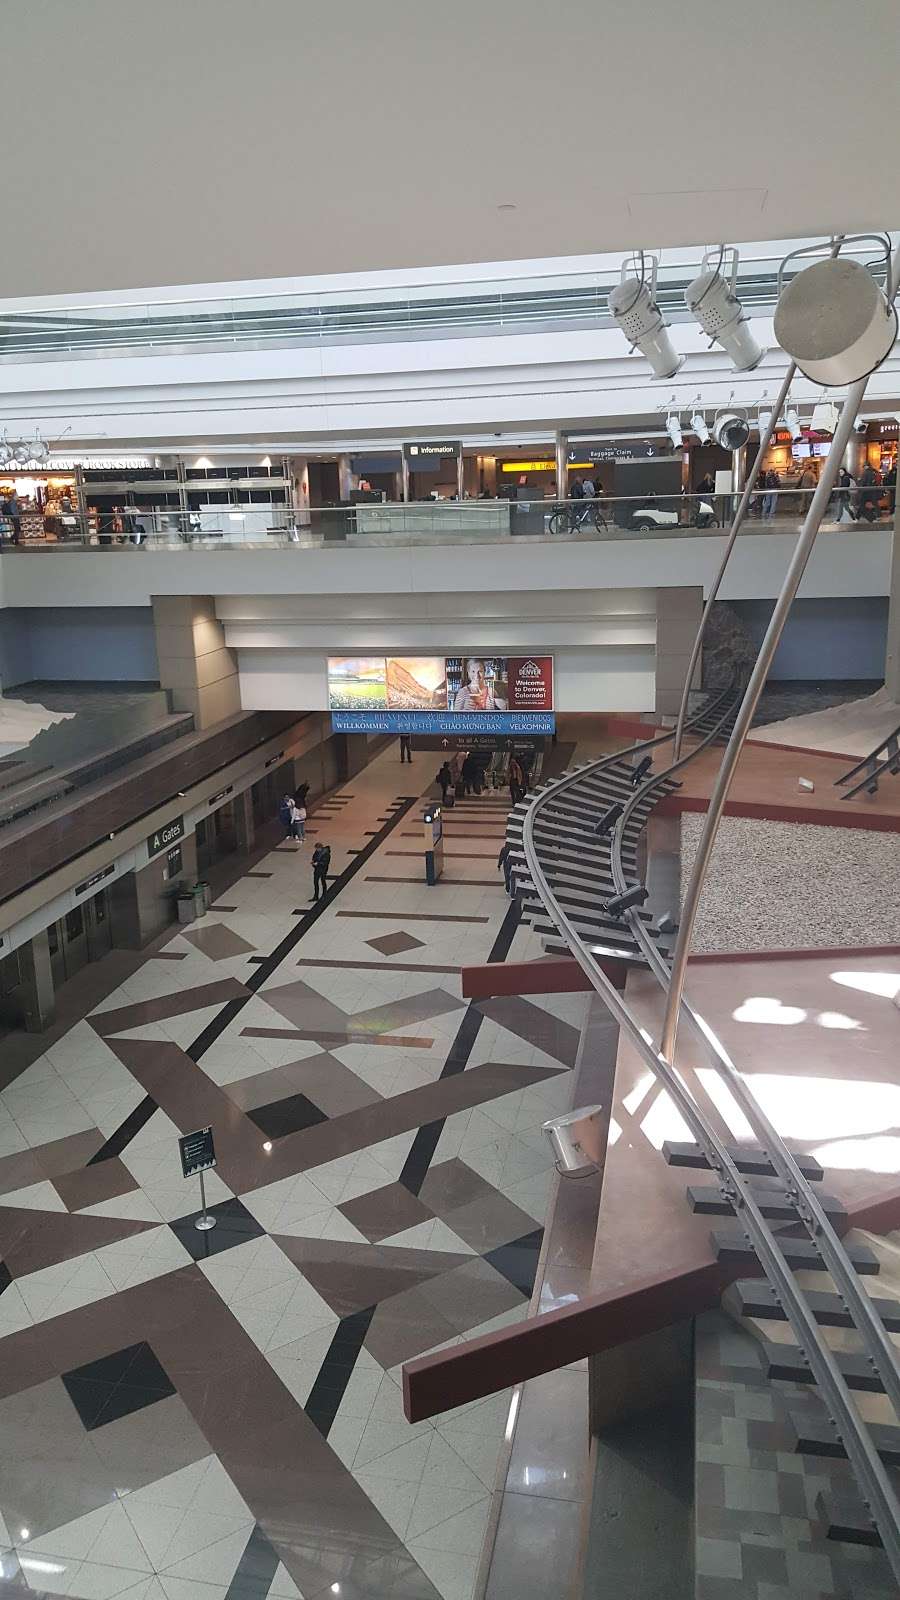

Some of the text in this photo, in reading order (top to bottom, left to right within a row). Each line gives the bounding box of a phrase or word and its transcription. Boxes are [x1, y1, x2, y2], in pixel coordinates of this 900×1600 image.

[420, 446, 453, 455] Information
[509, 723, 552, 731] VELKOMNIR
[153, 824, 181, 849] A Gates
